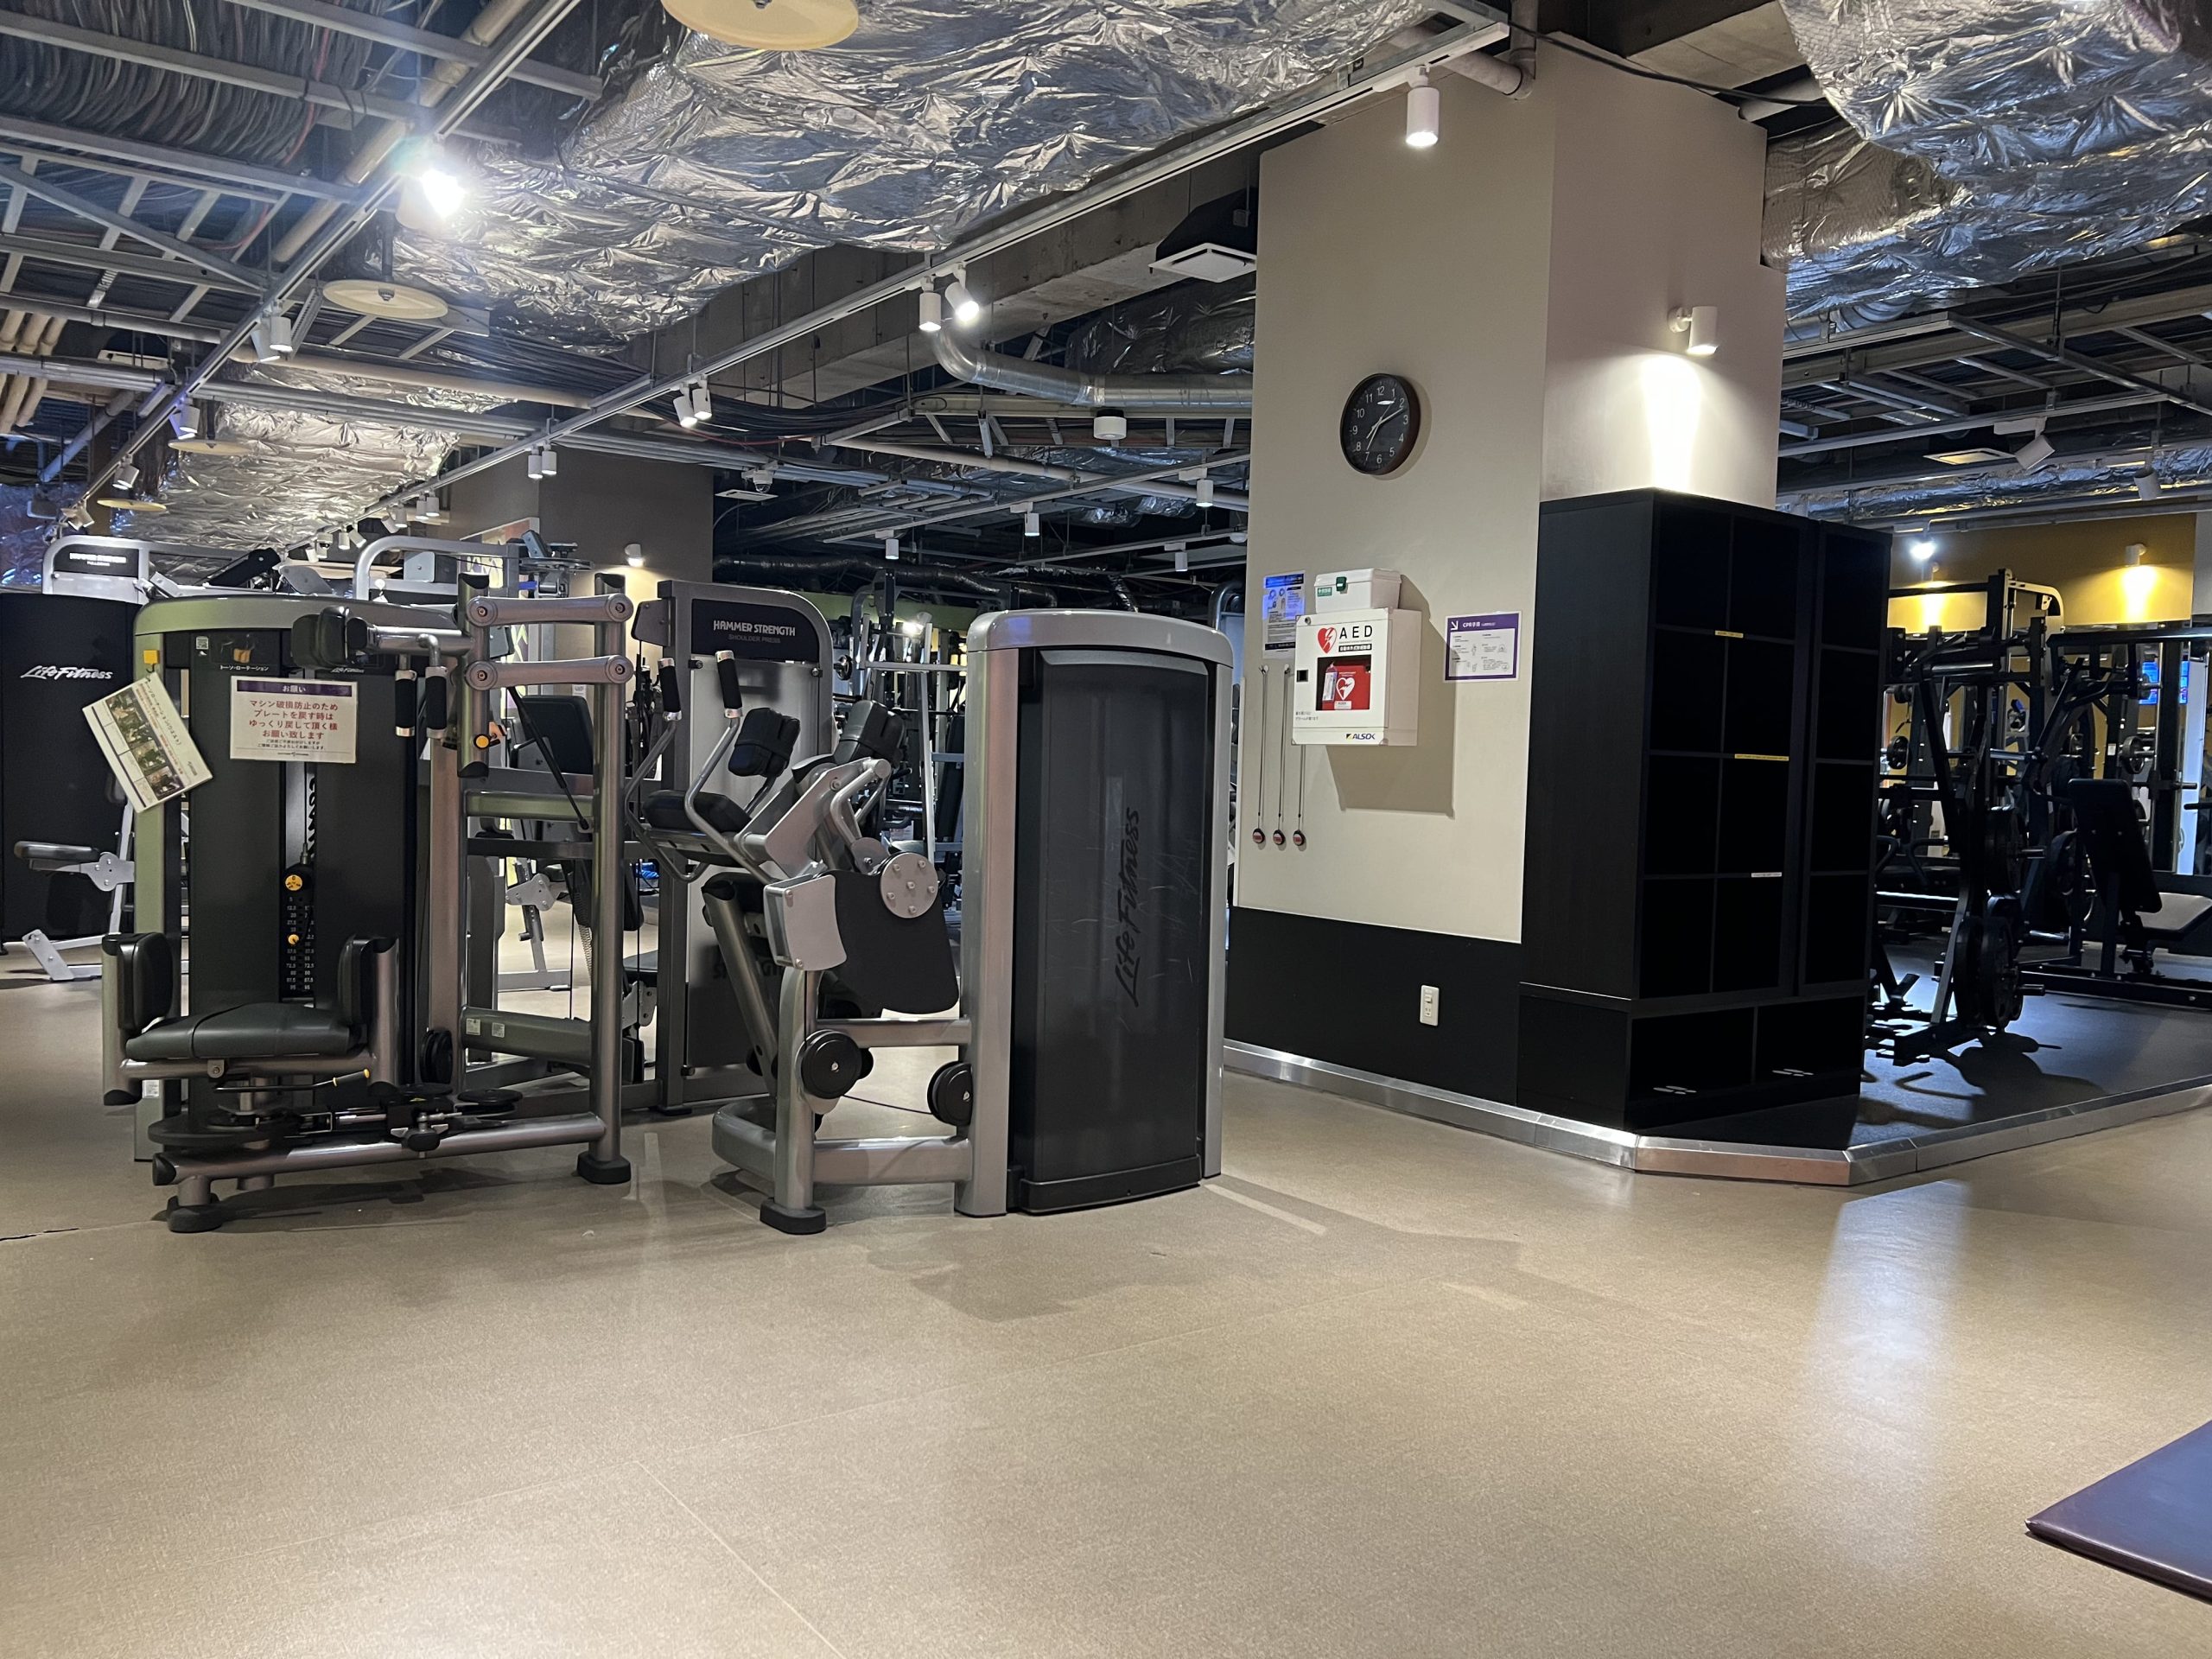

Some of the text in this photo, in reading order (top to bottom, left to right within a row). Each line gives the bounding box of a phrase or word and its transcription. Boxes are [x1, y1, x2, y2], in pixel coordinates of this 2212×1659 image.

[1376, 385, 1384, 396] 12
[1391, 388, 1395, 397] 1
[1366, 393, 1373, 404] 11
[1399, 398, 1405, 409] 2
[1357, 408, 1364, 418] 10
[1402, 415, 1408, 424] 3
[1352, 425, 1358, 435] 9
[1398, 433, 1404, 442] 4
[1356, 442, 1362, 451] 8
[1389, 447, 1395, 456] 5
[1365, 451, 1370, 461] 7
[1376, 454, 1382, 464] 6
[713, 620, 796, 637] HAMMER STRENGTH
[1339, 625, 1373, 639] AED
[20, 664, 113, 681] Life Fitness
[249, 700, 339, 711] マシン破損防止のため
[254, 709, 334, 721] プレートを戻す時は
[249, 720, 338, 731] ゆっくり戻して頂く様
[262, 729, 325, 741] お願い致します
[1115, 806, 1141, 1008] Life Fitness
